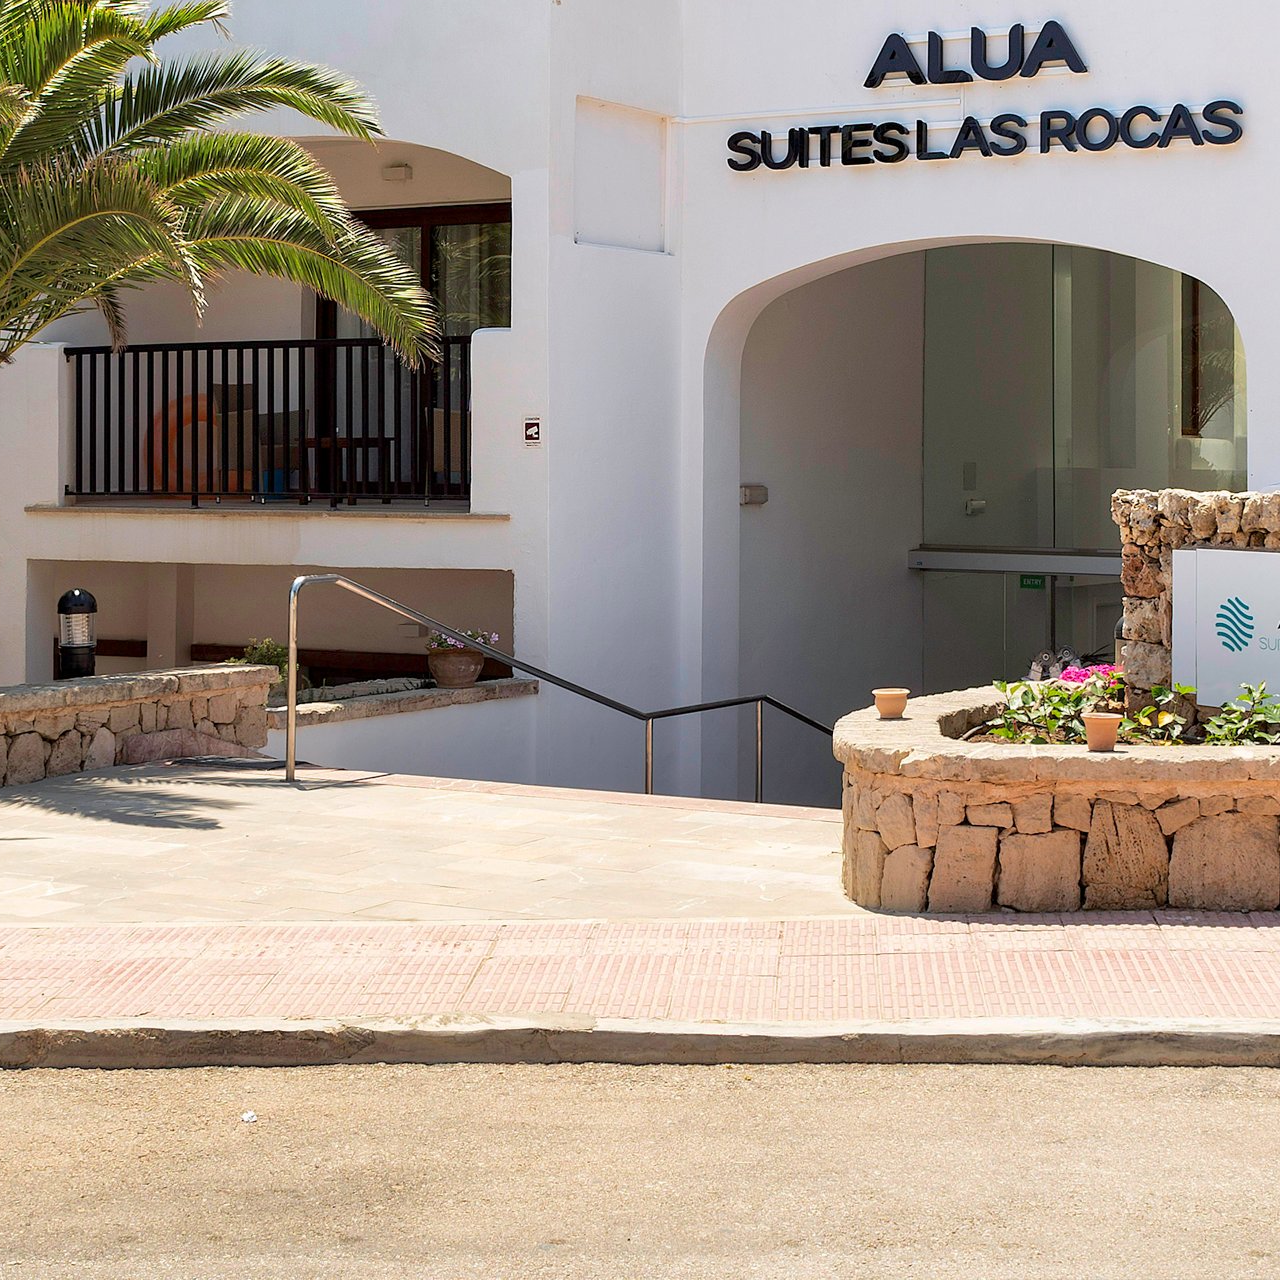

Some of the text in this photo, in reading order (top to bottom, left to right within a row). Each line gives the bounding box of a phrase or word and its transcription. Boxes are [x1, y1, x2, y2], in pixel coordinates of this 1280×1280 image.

[863, 20, 1088, 89] ALUA
[727, 100, 1244, 172] SUITES LAS ROCAS
